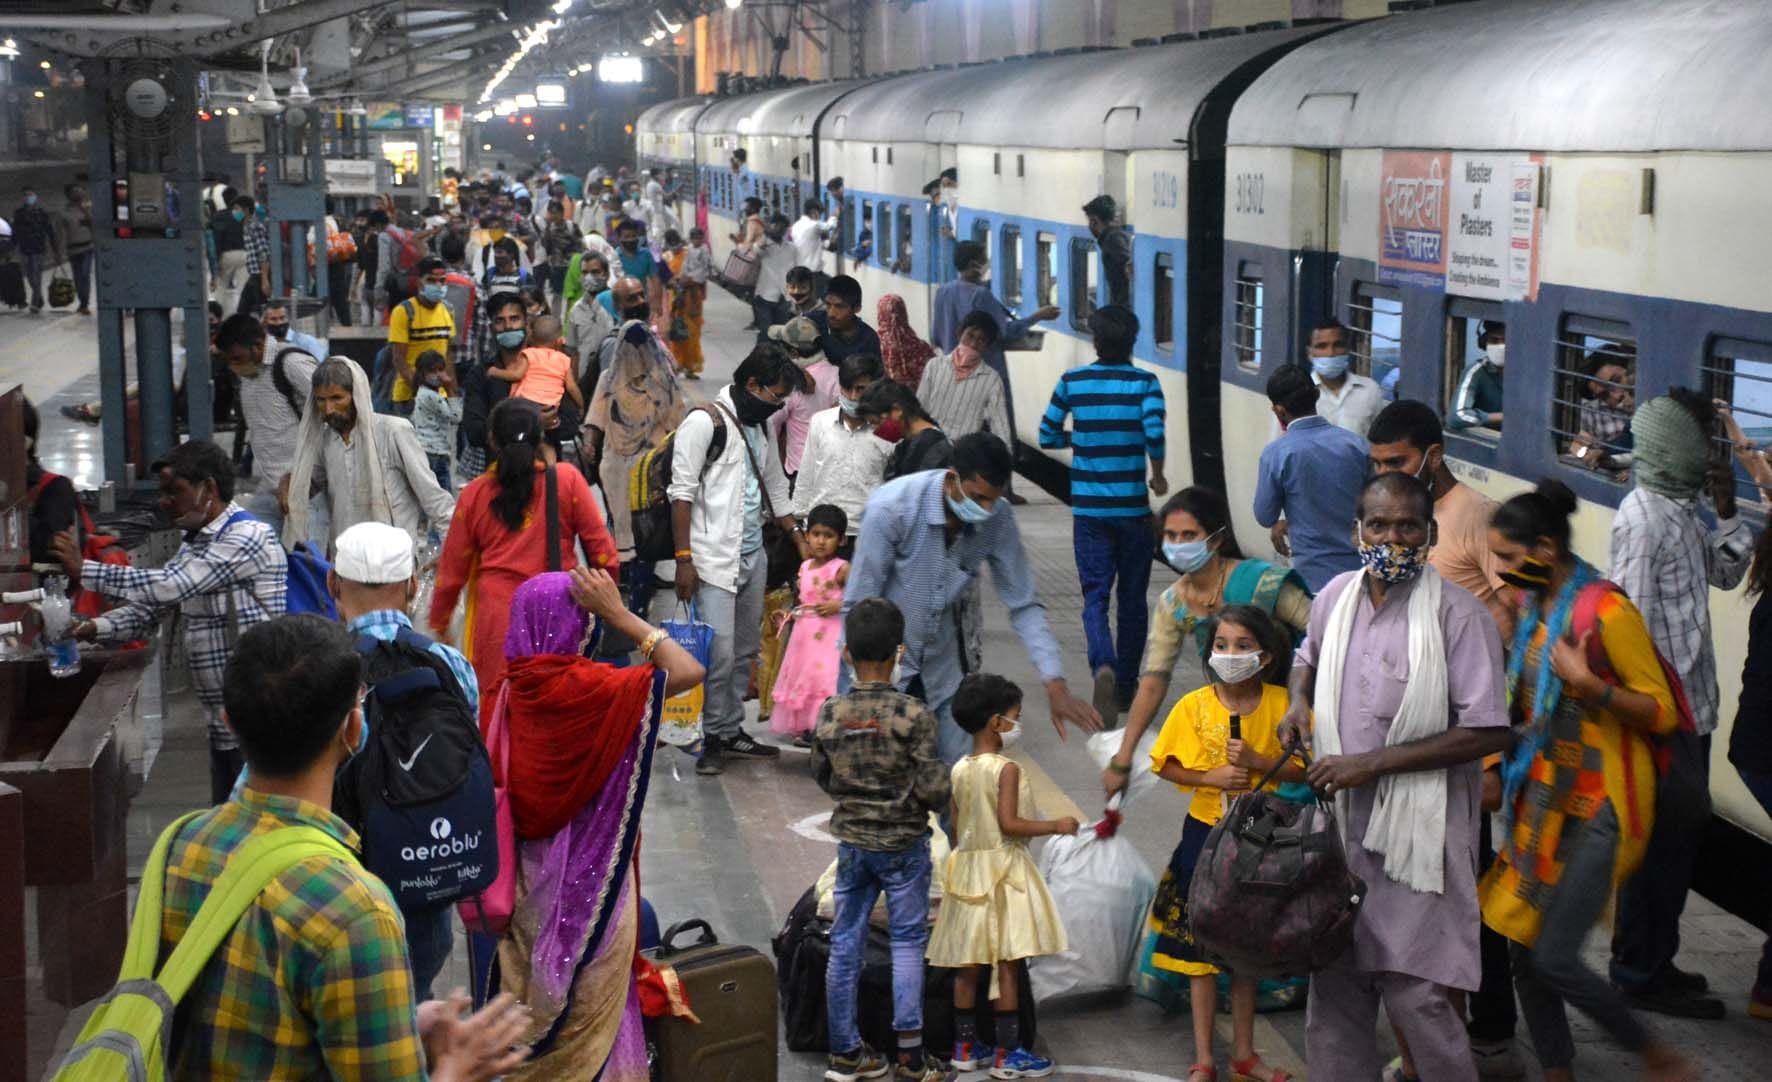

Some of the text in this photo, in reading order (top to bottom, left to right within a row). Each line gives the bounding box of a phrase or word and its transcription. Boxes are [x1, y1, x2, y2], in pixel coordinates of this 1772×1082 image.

[1465, 160, 1492, 183] Master
[1473, 188, 1482, 209] of
[1460, 213, 1492, 236] Plasters
[401, 832, 479, 861] aeroblu
